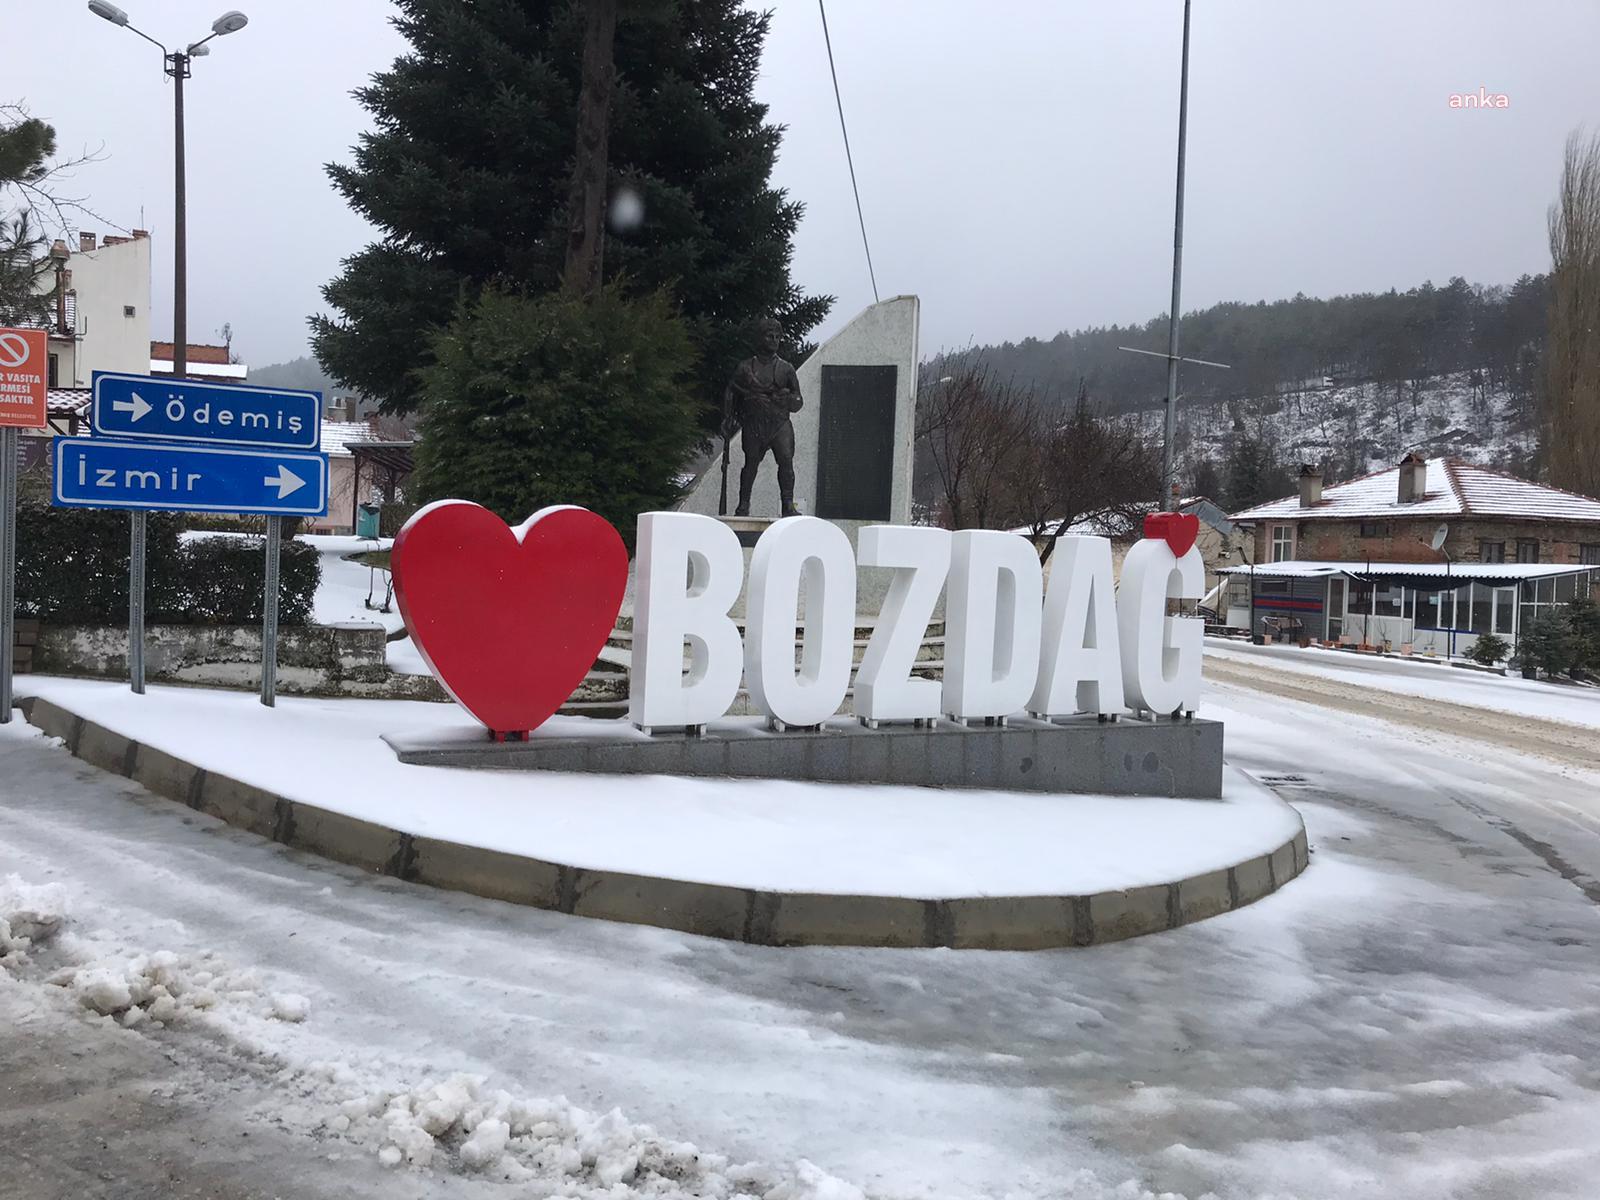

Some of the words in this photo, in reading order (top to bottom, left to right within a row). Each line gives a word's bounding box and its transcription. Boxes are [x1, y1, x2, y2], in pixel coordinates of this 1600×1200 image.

[7, 373, 41, 384] VASITA
[165, 394, 303, 434] Ödemiş
[78, 453, 202, 491] İzmir
